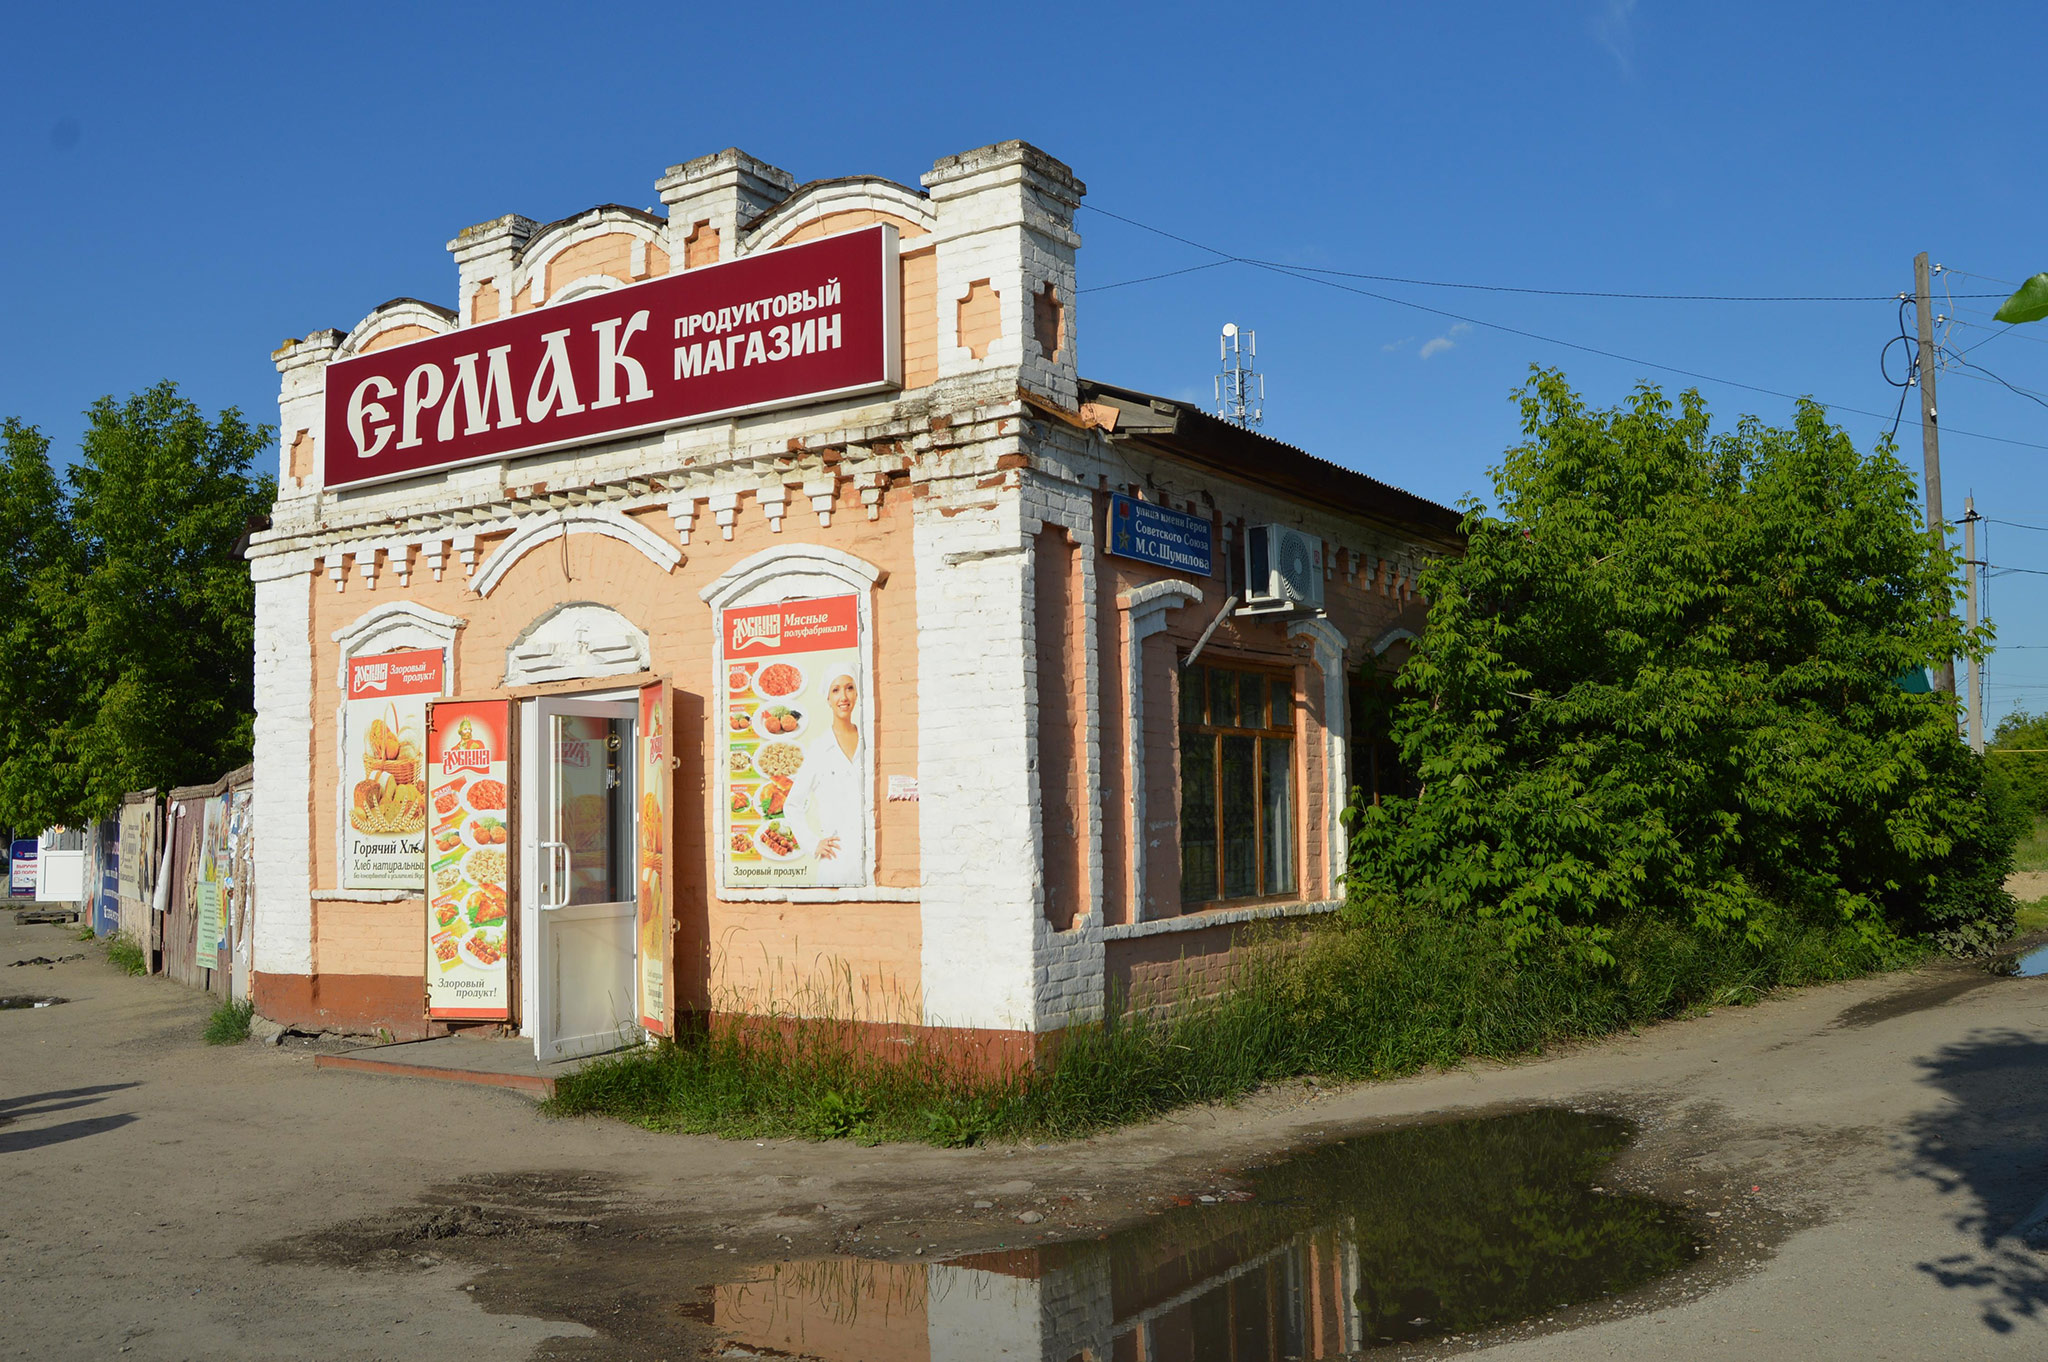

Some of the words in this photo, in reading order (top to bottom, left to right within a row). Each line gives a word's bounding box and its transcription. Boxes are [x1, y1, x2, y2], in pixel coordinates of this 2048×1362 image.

[674, 277, 841, 339] ПРОДУКТОВЫЙ
[673, 313, 842, 381] МАГАЗИН
[1135, 506, 1159, 520] улица
[1160, 512, 1185, 527] имени
[1186, 517, 1208, 534] Героя
[1135, 520, 1182, 544] Советского
[1183, 533, 1209, 551] Союза
[1135, 537, 1210, 570] М.С.Шумилова
[784, 613, 829, 627] Мясные
[784, 624, 848, 638] полуфабрикаты
[389, 662, 426, 676] Здоровый
[403, 669, 436, 684] продукт!
[353, 840, 397, 857] Горячий
[353, 859, 371, 871] Хлеб
[733, 865, 772, 877] Здоровый
[773, 865, 808, 877] продукт!
[438, 978, 485, 990] Здоровый
[456, 987, 497, 999] продукт!
